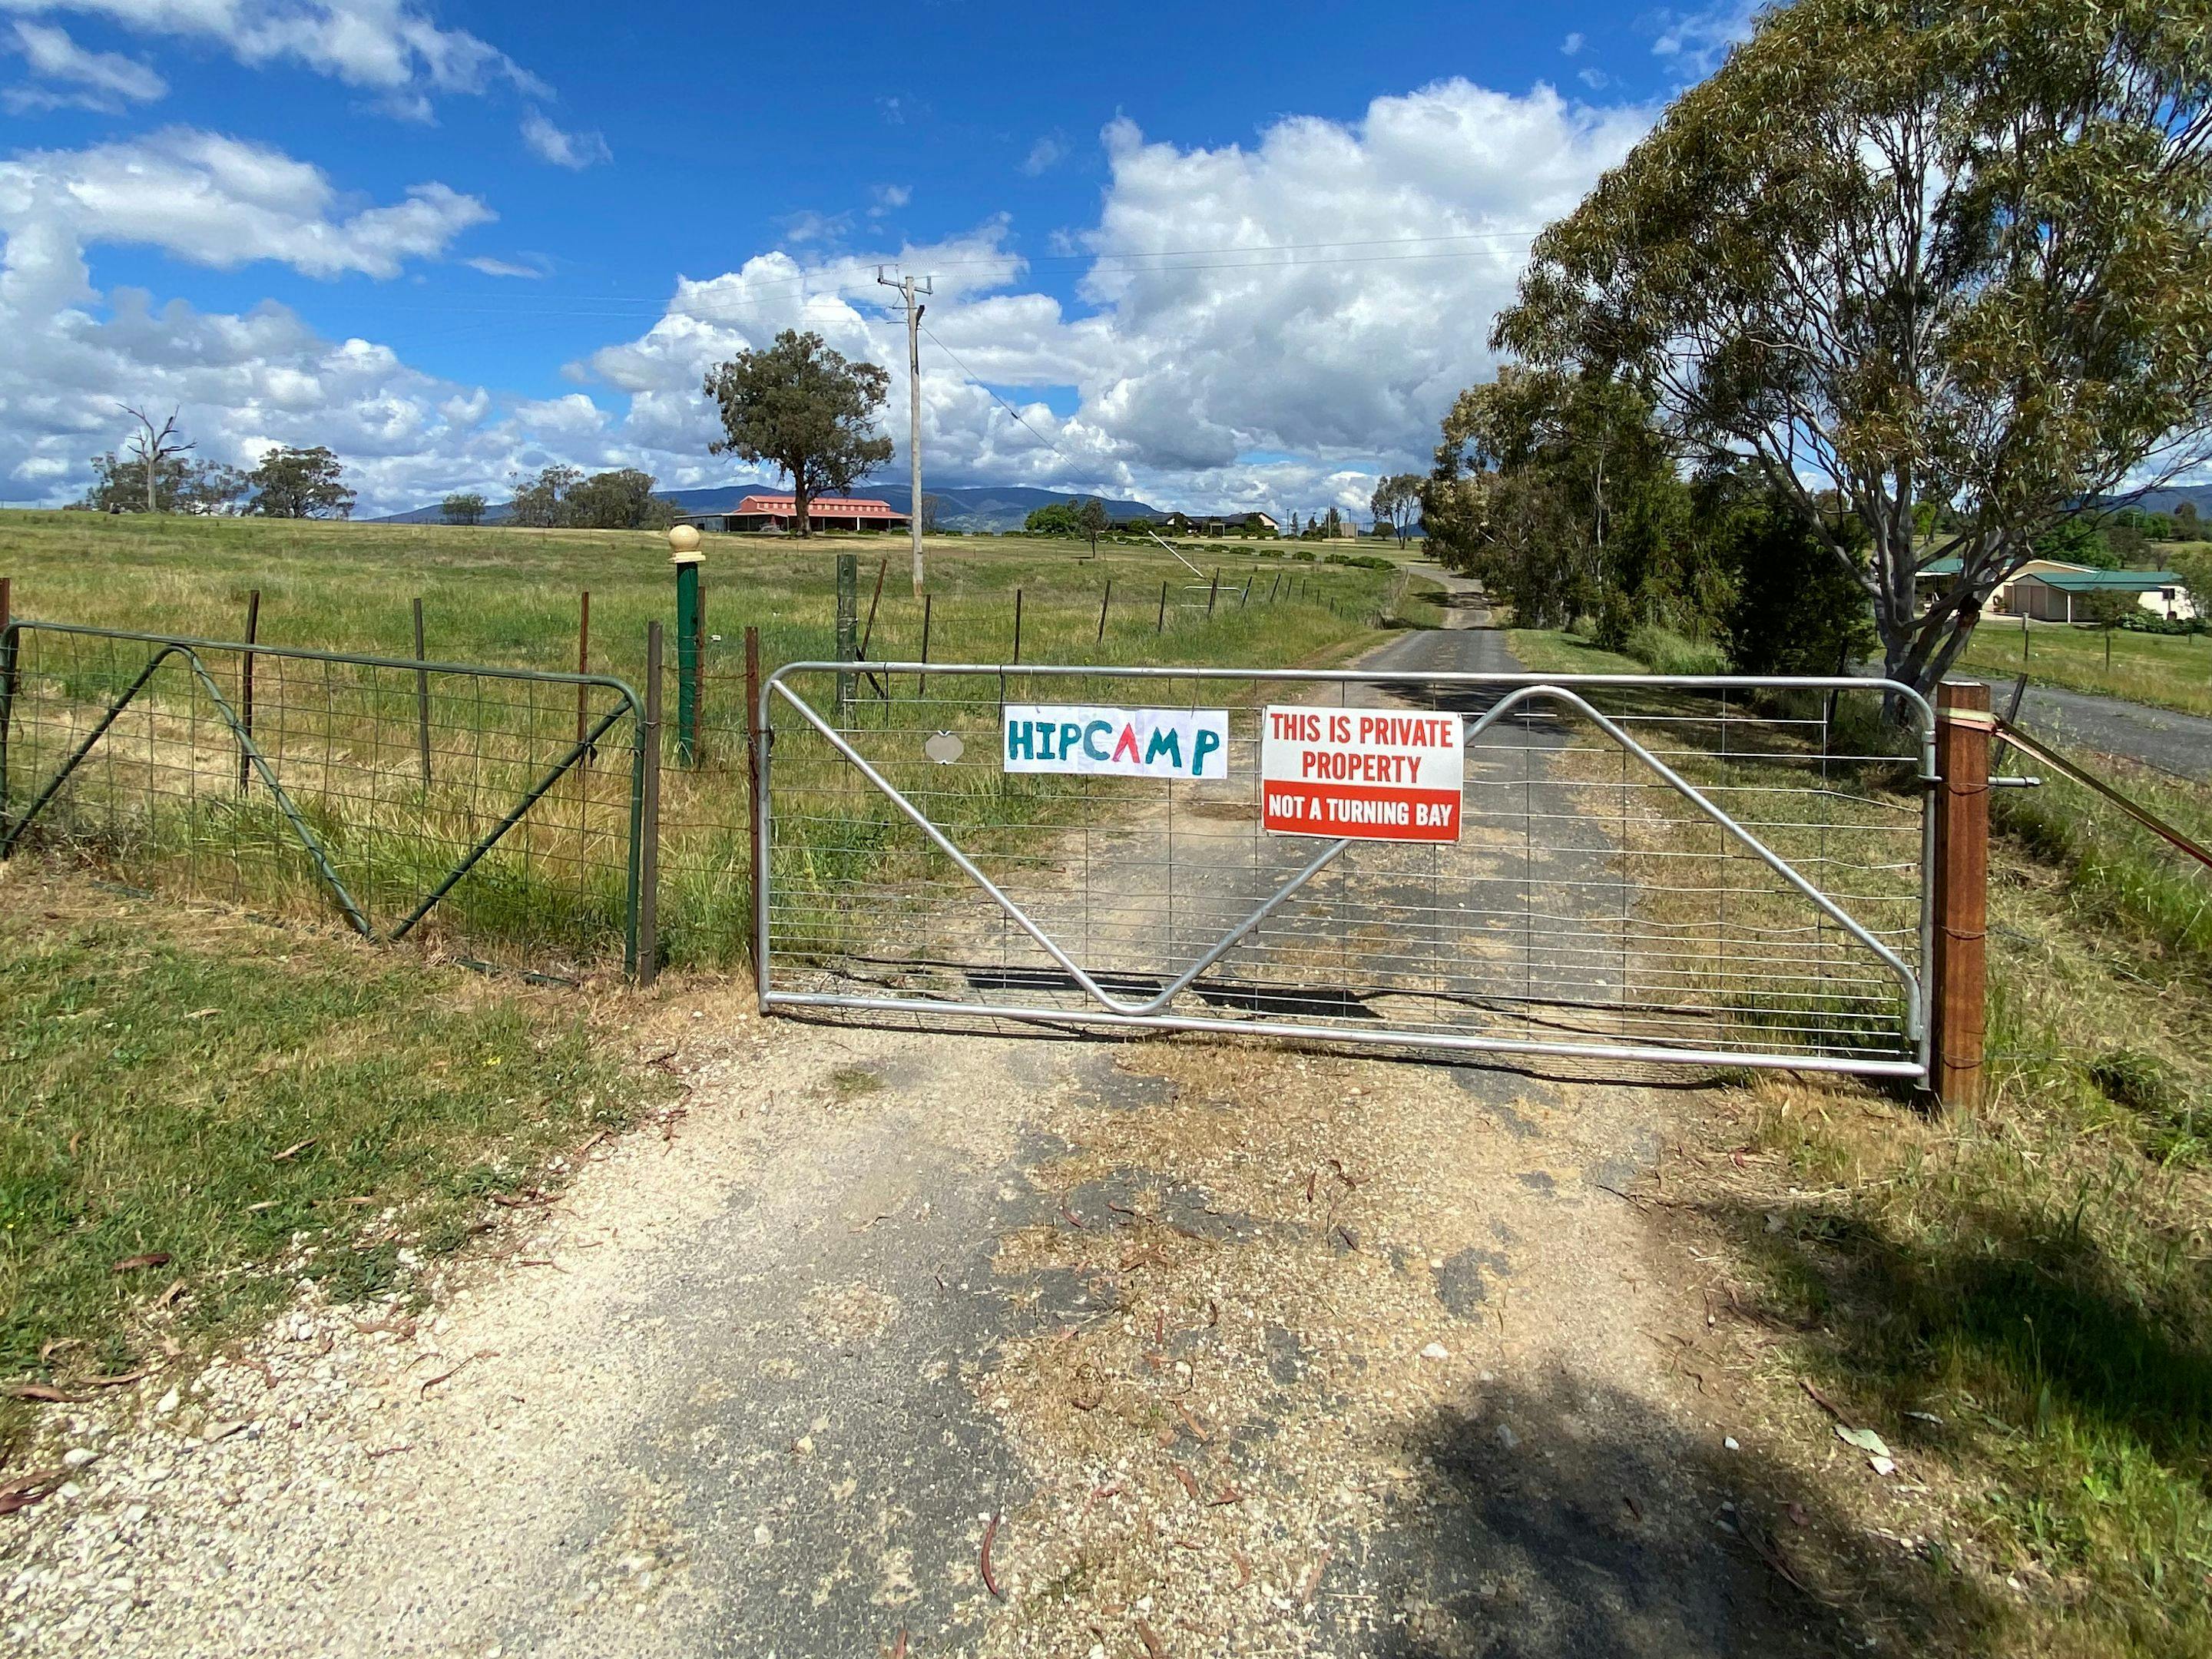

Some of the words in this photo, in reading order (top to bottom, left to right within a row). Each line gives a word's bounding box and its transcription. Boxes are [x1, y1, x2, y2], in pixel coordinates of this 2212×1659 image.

[1008, 720, 1220, 775] HIPCAMP
[1270, 714, 1320, 743] THIS
[1330, 716, 1351, 743] IS
[1360, 717, 1454, 748] PRIVATE
[1302, 750, 1422, 783] PROPERTY
[1268, 793, 1304, 819] NOT
[1309, 796, 1322, 820] A
[1326, 797, 1409, 826] TURNING
[1415, 802, 1454, 827] BAY
